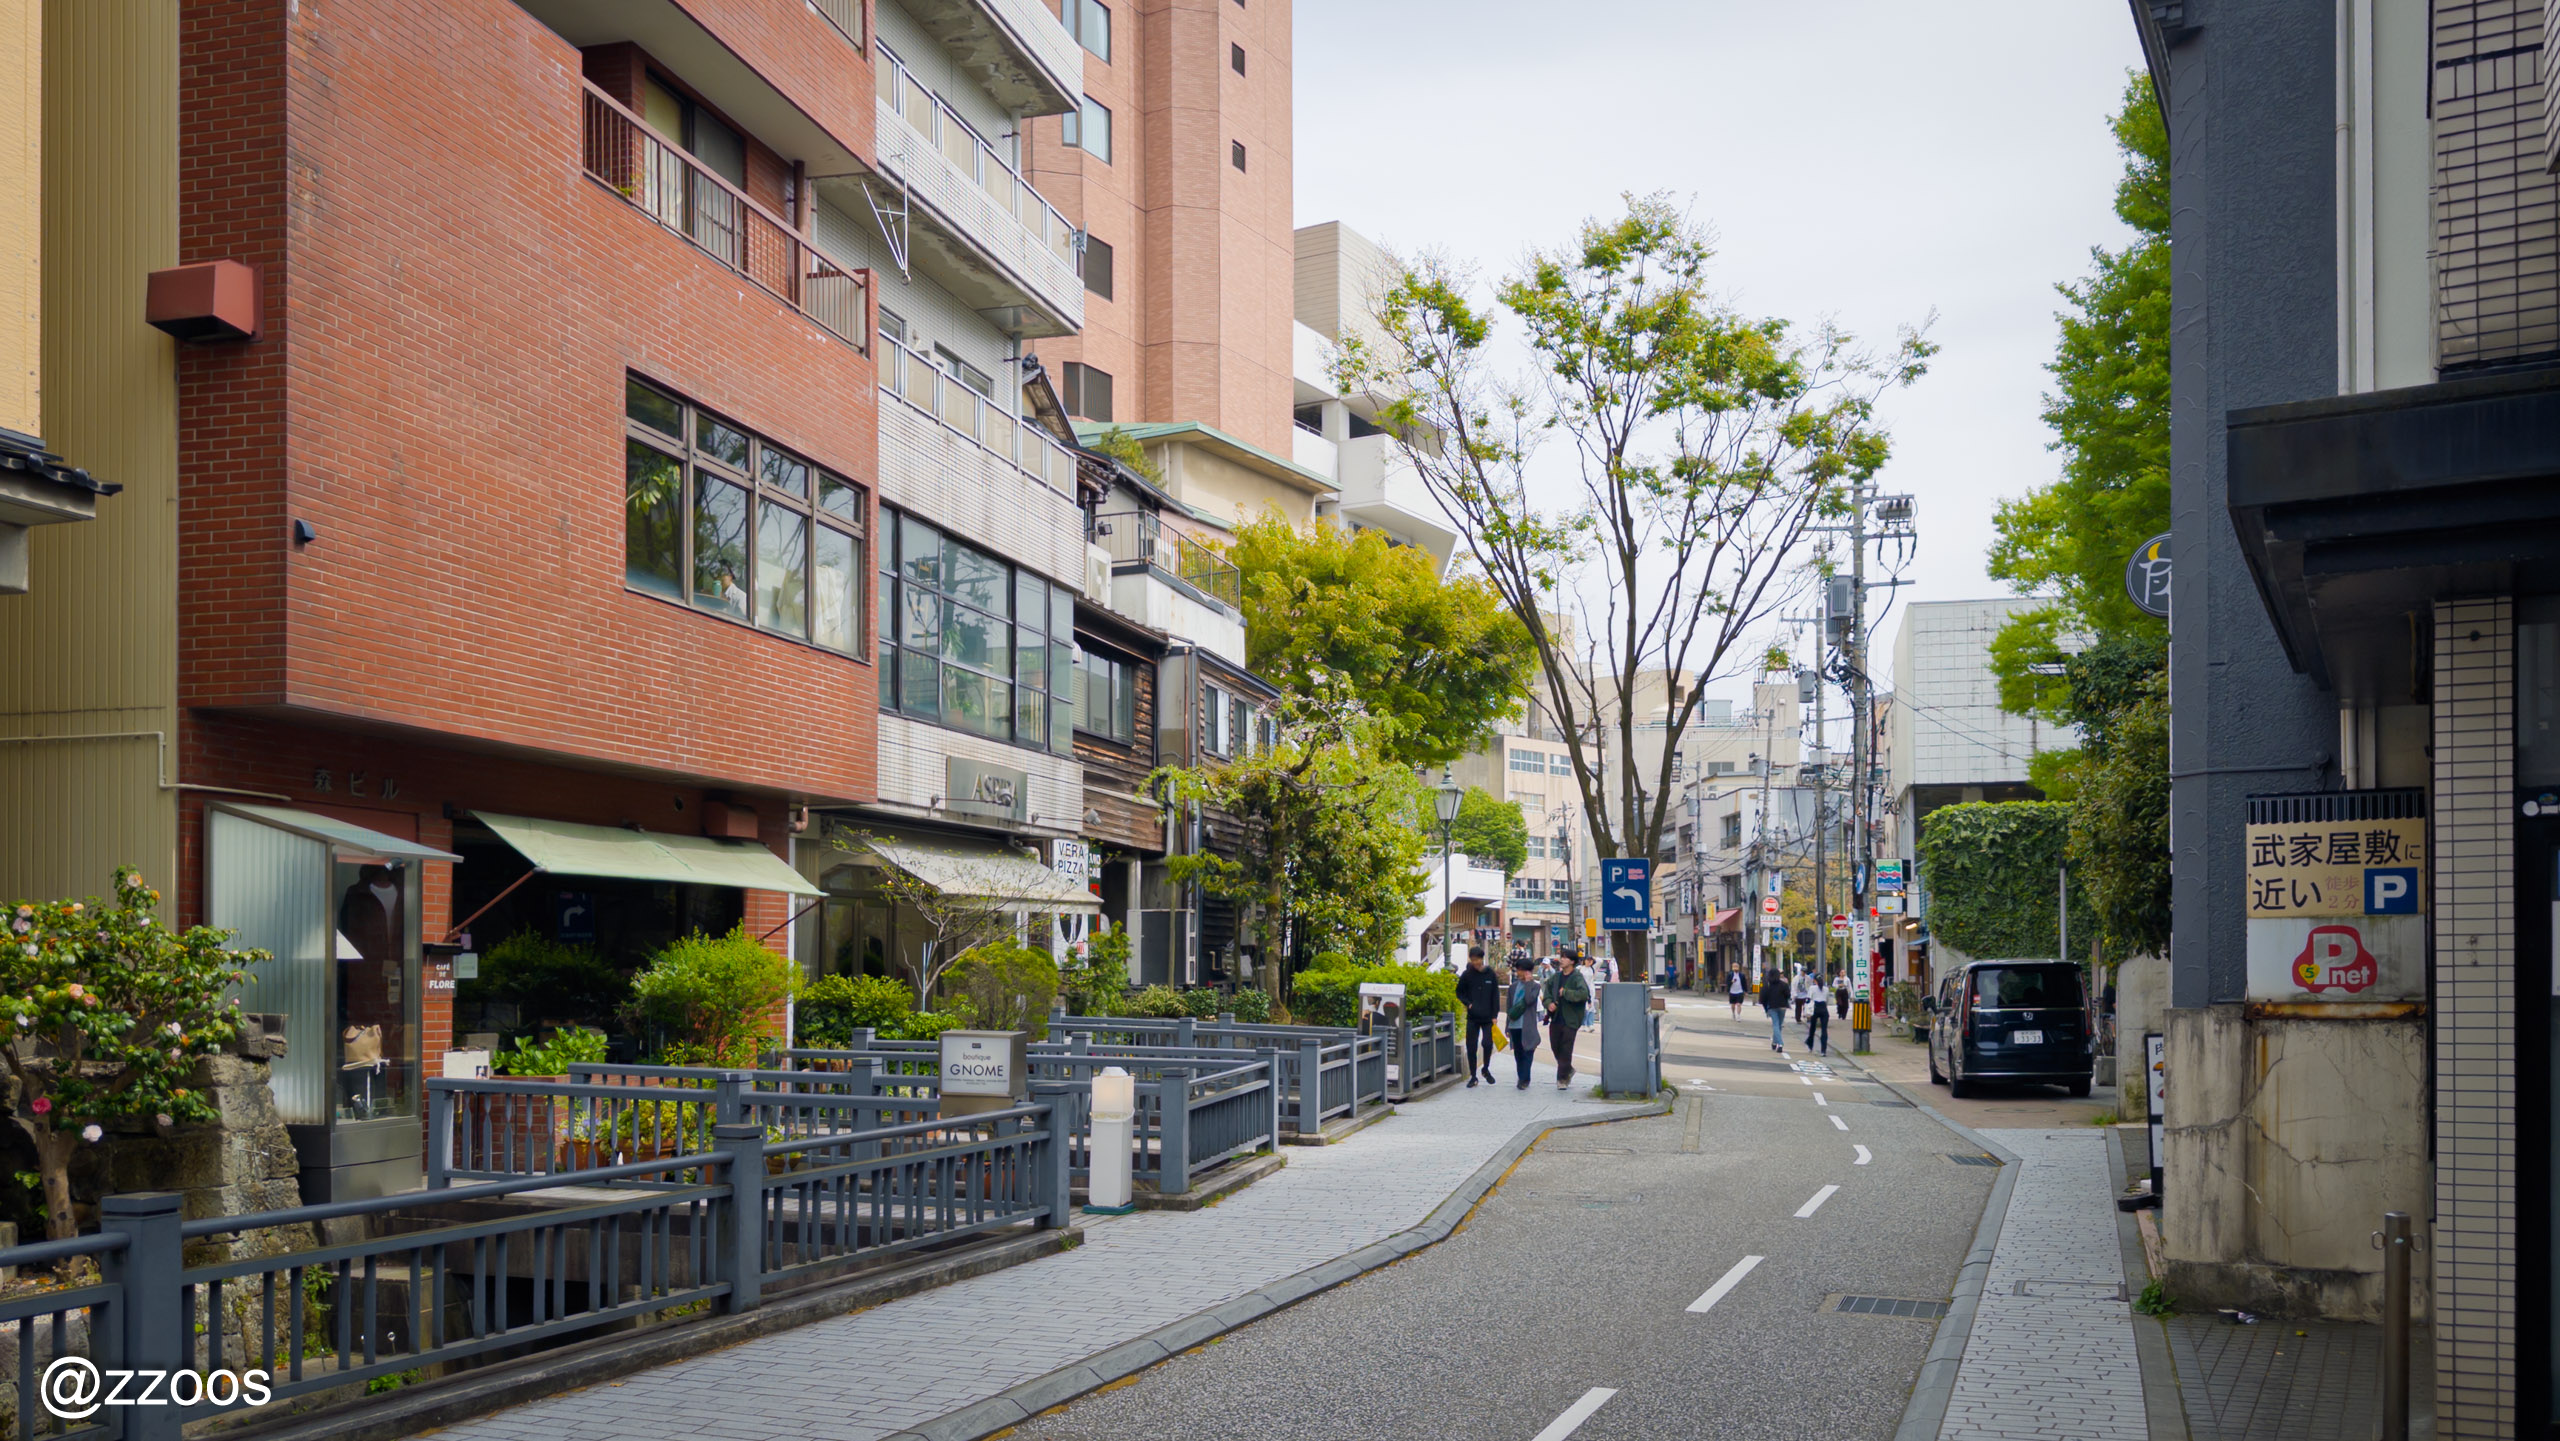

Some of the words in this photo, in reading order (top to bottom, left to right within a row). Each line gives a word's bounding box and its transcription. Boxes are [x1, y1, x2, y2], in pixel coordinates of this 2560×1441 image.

[314, 768, 400, 800] 森ビル
[1058, 842, 1084, 860] VERA
[2251, 829, 2422, 868] 武家屋敷に
[1057, 860, 1085, 876] PIZZA
[1611, 866, 1623, 882] P
[2326, 875, 2360, 891] 徒歩
[2252, 877, 2322, 912] 近い
[2373, 874, 2408, 910] P
[435, 963, 450, 971] CAFÉ
[428, 980, 455, 990] FLORE
[962, 1051, 992, 1062] boutique
[949, 1063, 1005, 1077] GNOME
